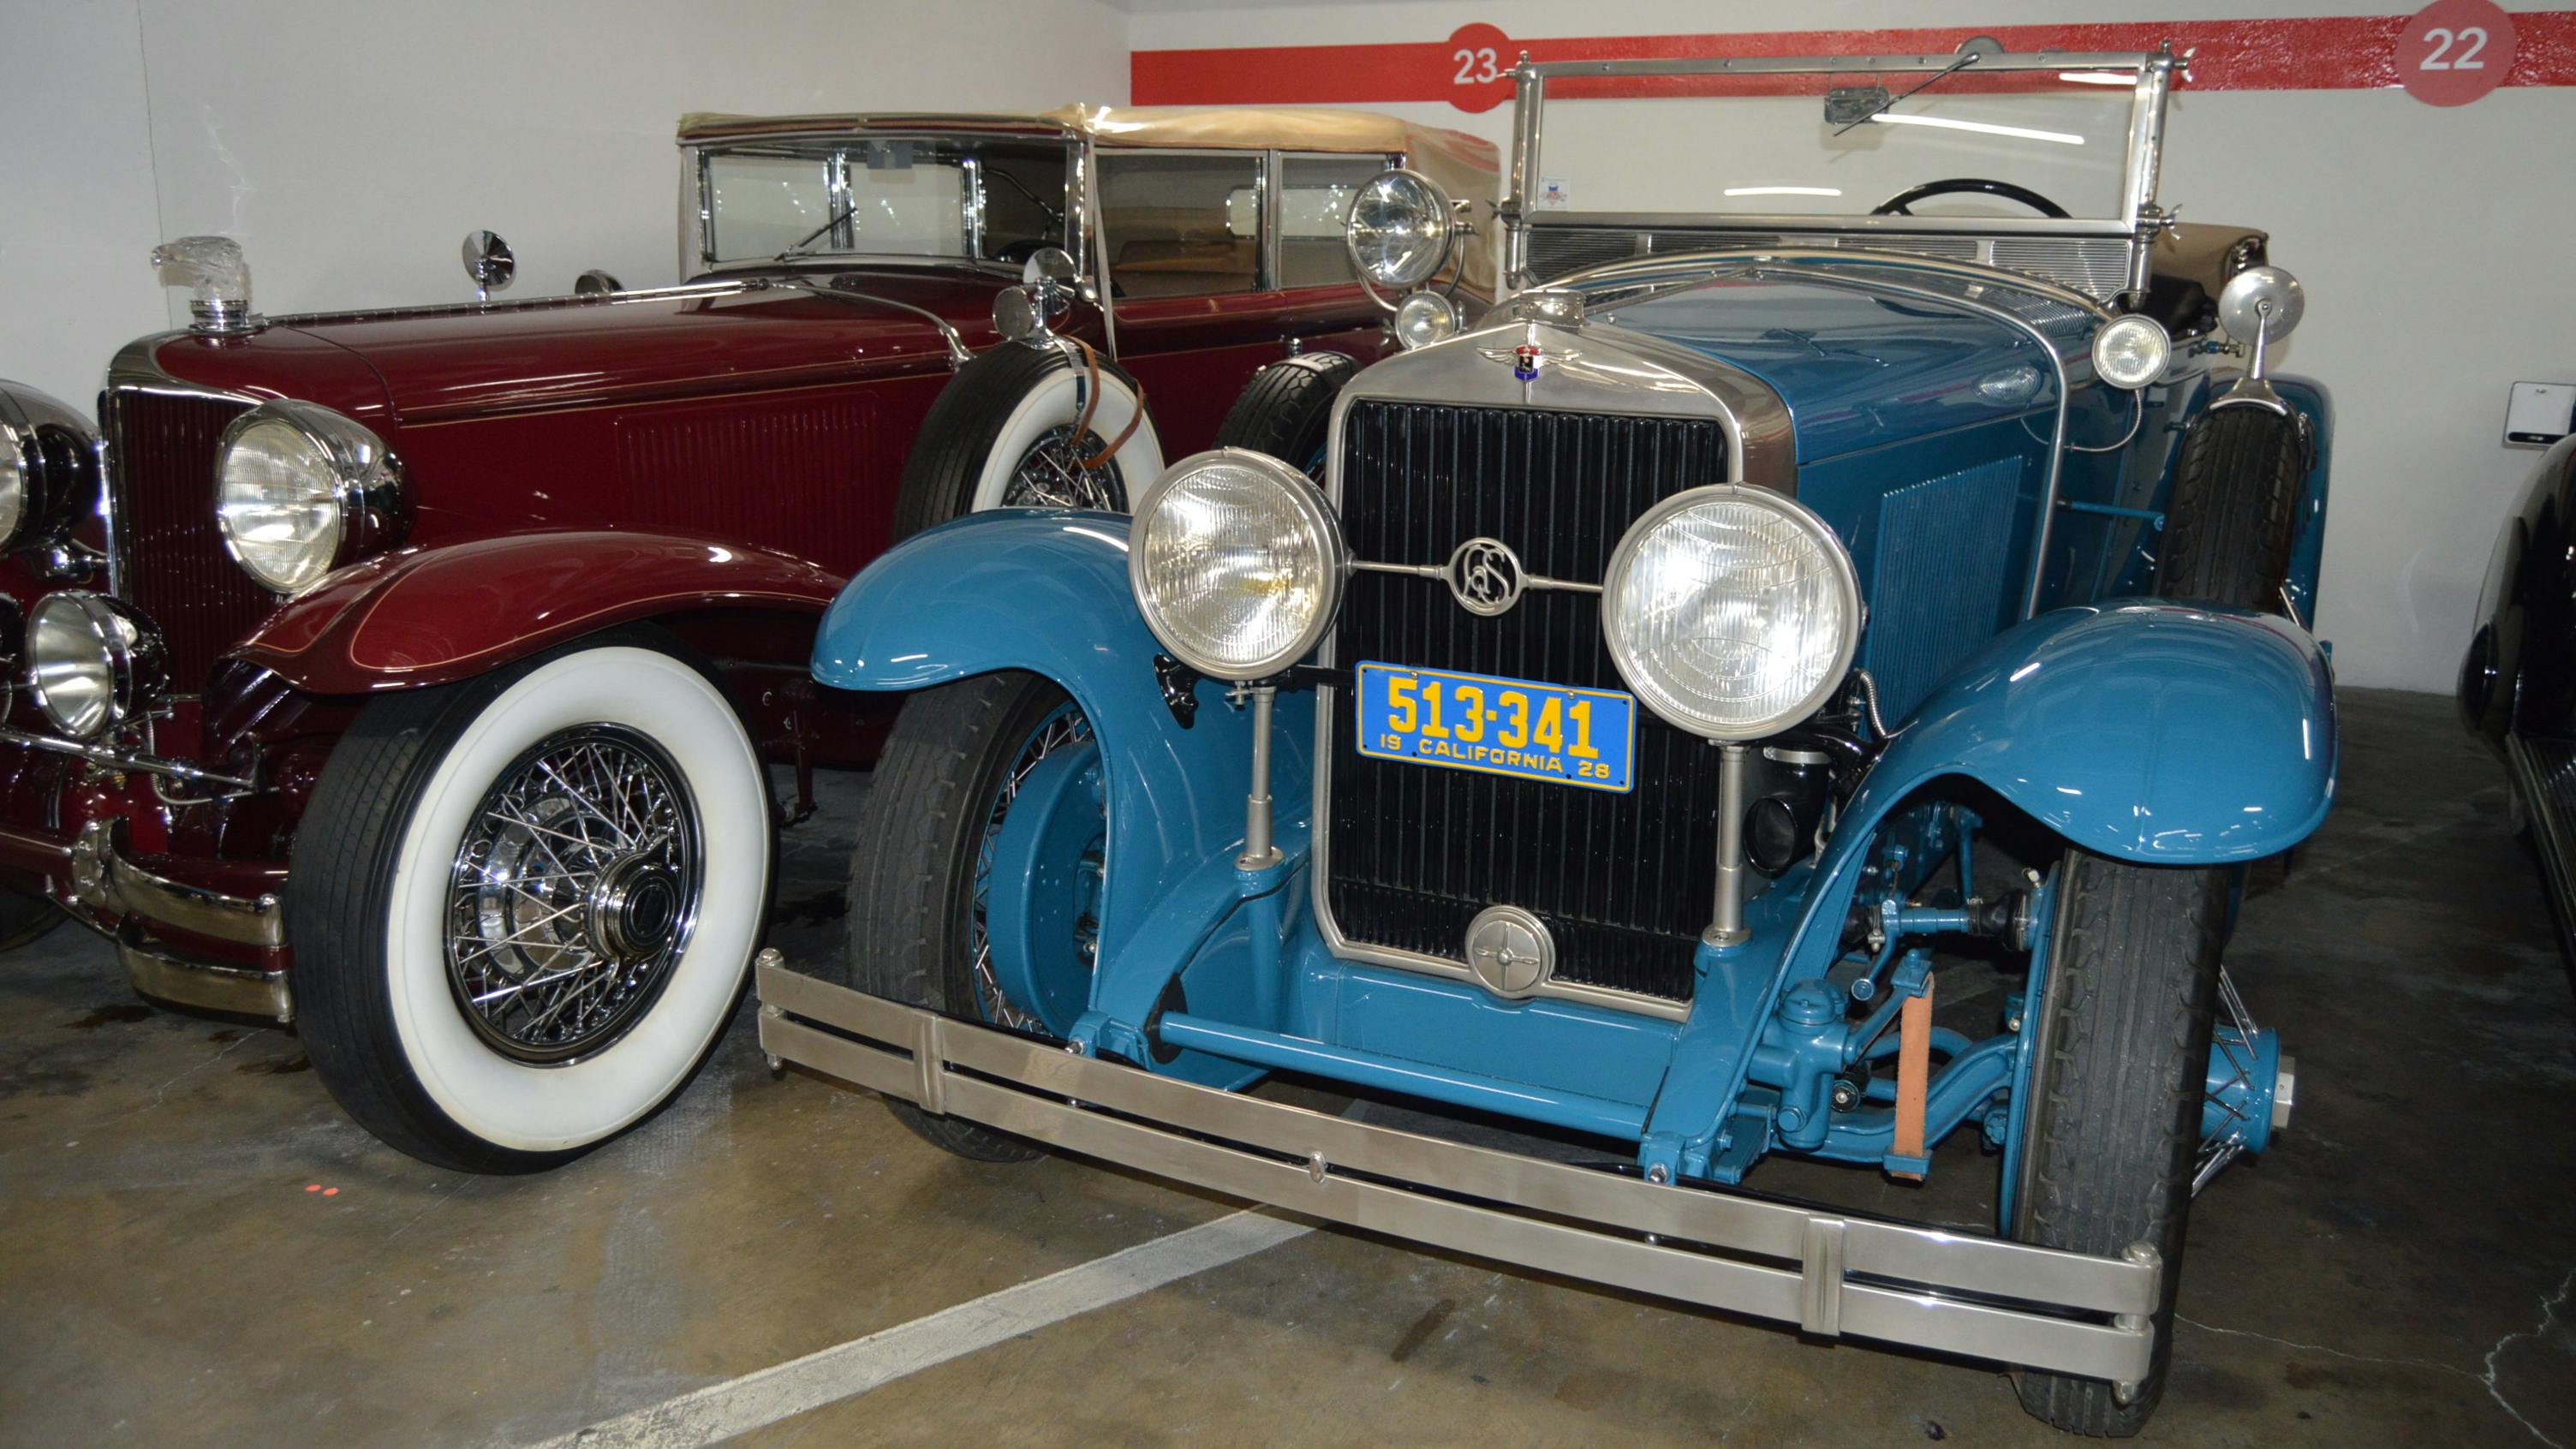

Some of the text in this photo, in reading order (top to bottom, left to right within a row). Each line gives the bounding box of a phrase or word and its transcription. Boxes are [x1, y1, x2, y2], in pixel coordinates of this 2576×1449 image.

[1453, 48, 1498, 84] 23
[2420, 27, 2488, 70] 22
[1387, 676, 1599, 760] 513-341
[1380, 733, 1611, 780] 19 CALIFORNIA 28
